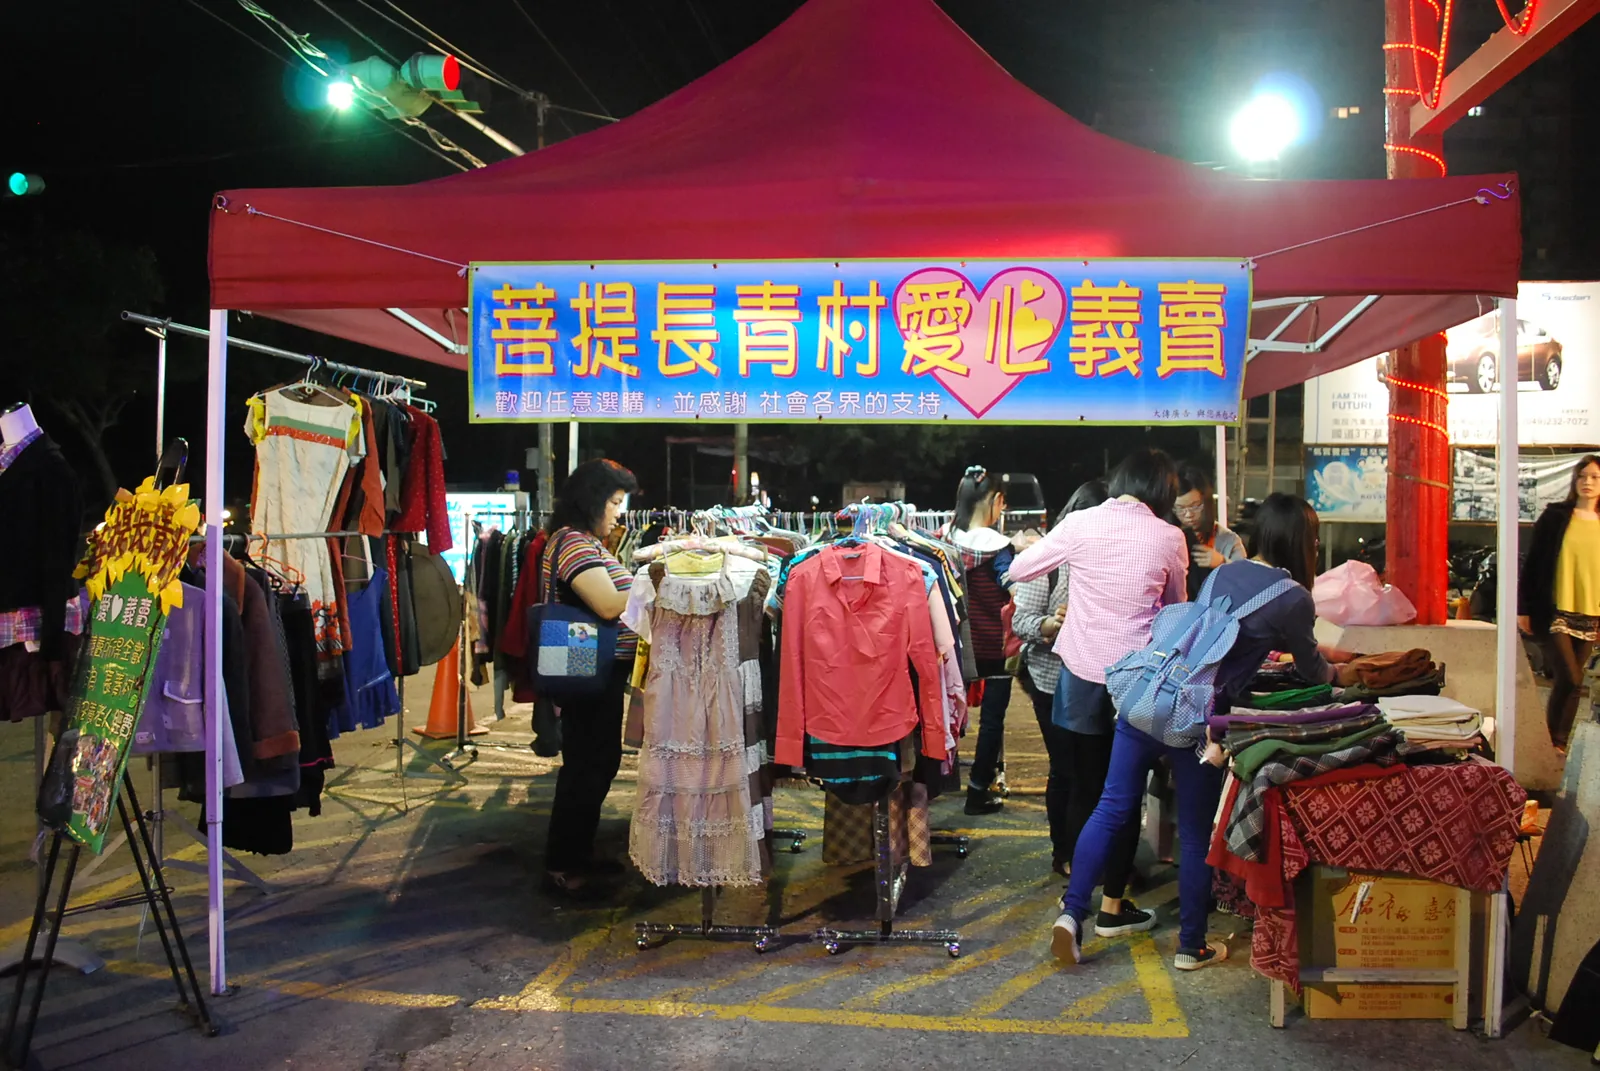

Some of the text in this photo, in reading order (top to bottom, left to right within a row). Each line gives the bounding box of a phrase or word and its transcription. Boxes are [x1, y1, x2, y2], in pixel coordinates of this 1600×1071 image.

[491, 280, 1227, 380] 菩提長青村愛心義賣
[759, 390, 941, 416] 社會各界的支持
